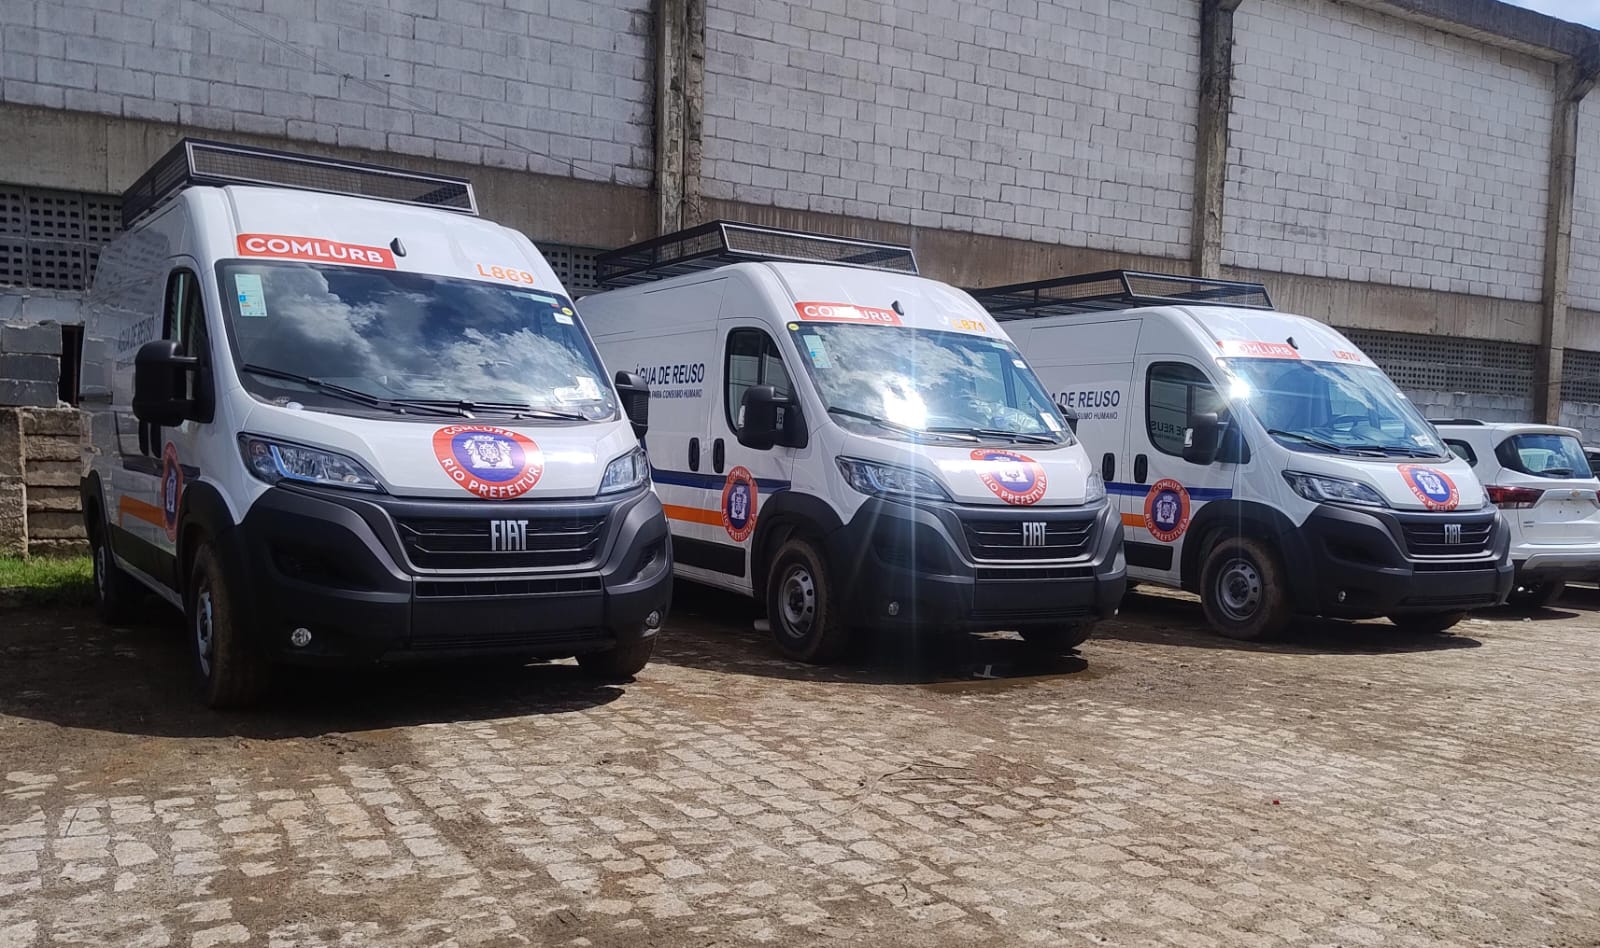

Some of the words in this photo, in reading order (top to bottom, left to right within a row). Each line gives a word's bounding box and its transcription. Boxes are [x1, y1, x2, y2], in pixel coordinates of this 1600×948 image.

[245, 237, 383, 263] COMLURB
[476, 263, 534, 284] L869
[659, 366, 671, 384] DE
[672, 363, 705, 384] REUSO
[1060, 391, 1075, 408] DE
[1078, 390, 1120, 408] REUSO
[443, 424, 514, 437] COMLURB
[442, 457, 465, 481] RIO
[1001, 475, 1047, 505] PREFEITURA
[1411, 486, 1426, 502] RIO
[491, 519, 529, 552] FIAT
[1022, 521, 1047, 546] FIAT
[1444, 523, 1462, 545] FIAT
